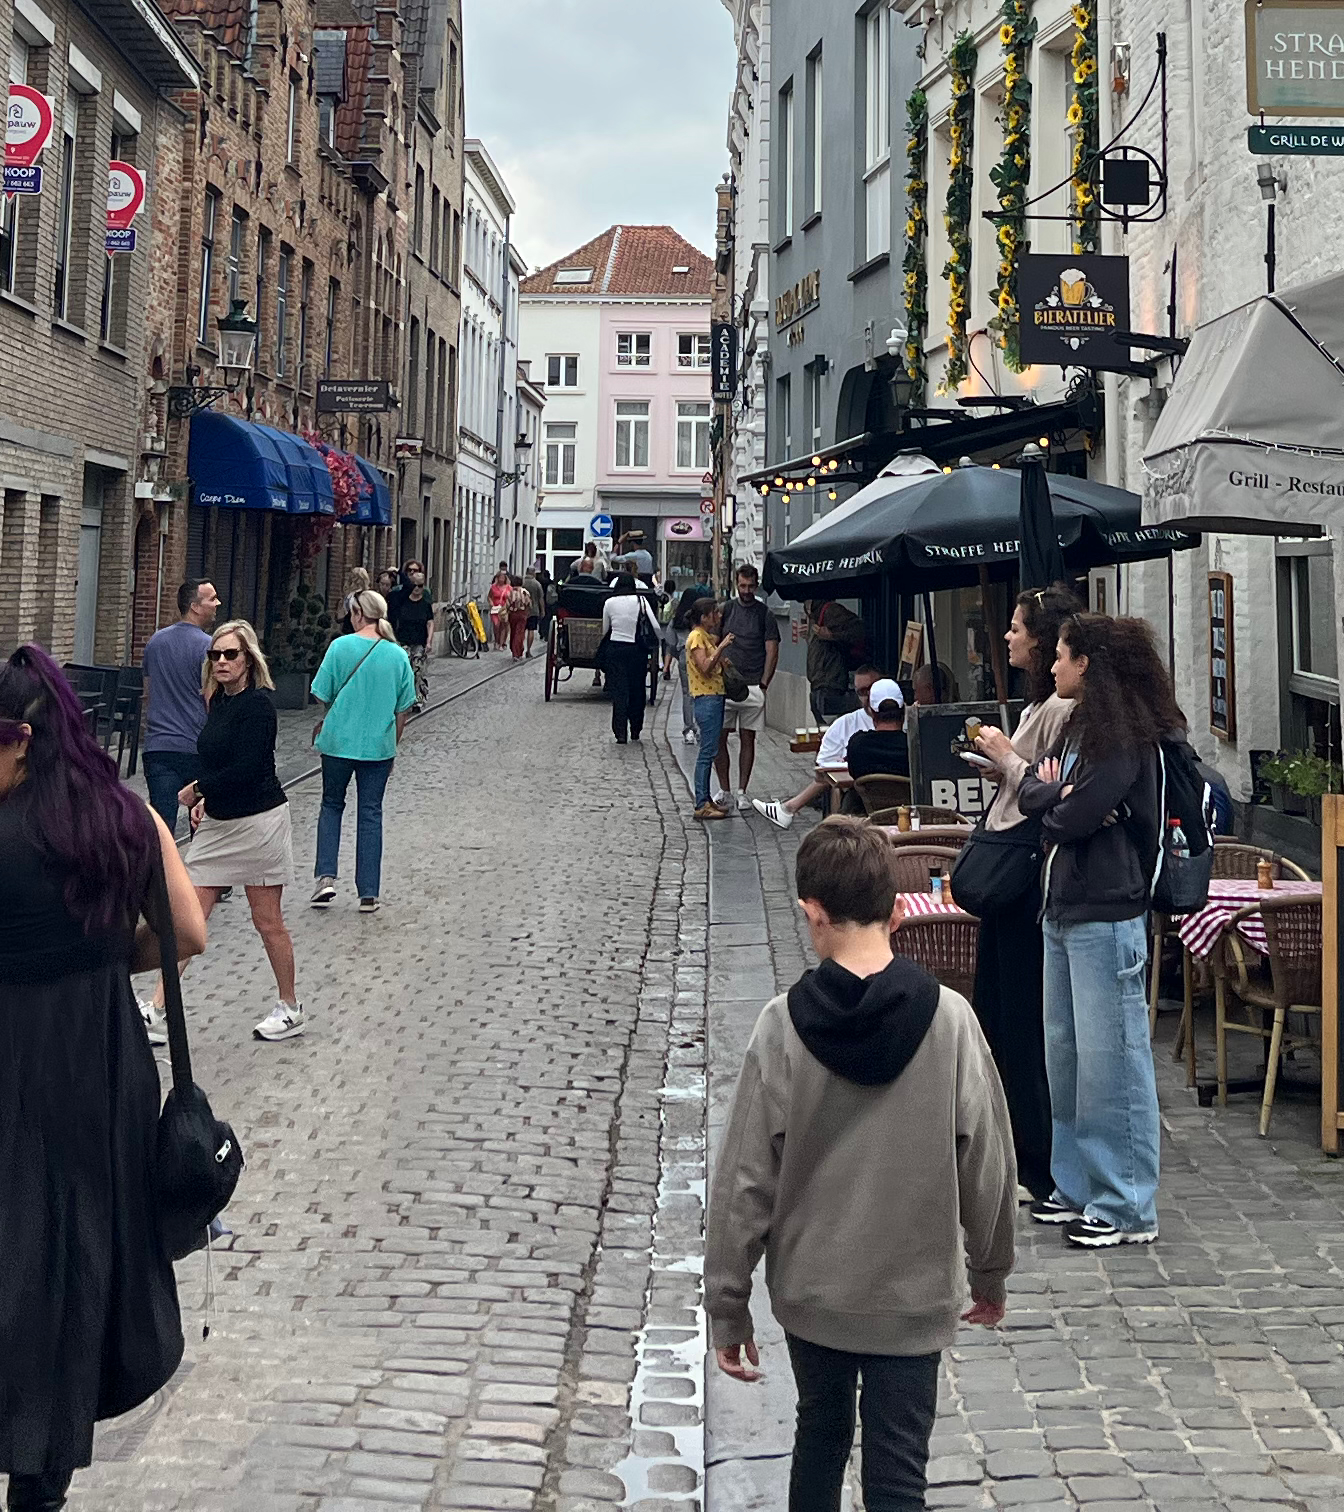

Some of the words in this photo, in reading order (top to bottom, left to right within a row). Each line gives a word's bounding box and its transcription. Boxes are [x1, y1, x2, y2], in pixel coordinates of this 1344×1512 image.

[1269, 133, 1309, 148] GRILL
[1310, 135, 1329, 147] DE
[1034, 310, 1116, 327] BIERATELIER
[719, 328, 731, 391] ACADEMIE
[1229, 470, 1269, 489] Grill
[925, 543, 985, 559] STRAFFE
[782, 559, 835, 577] STRAFFE
[838, 548, 884, 570] HENDRIK
